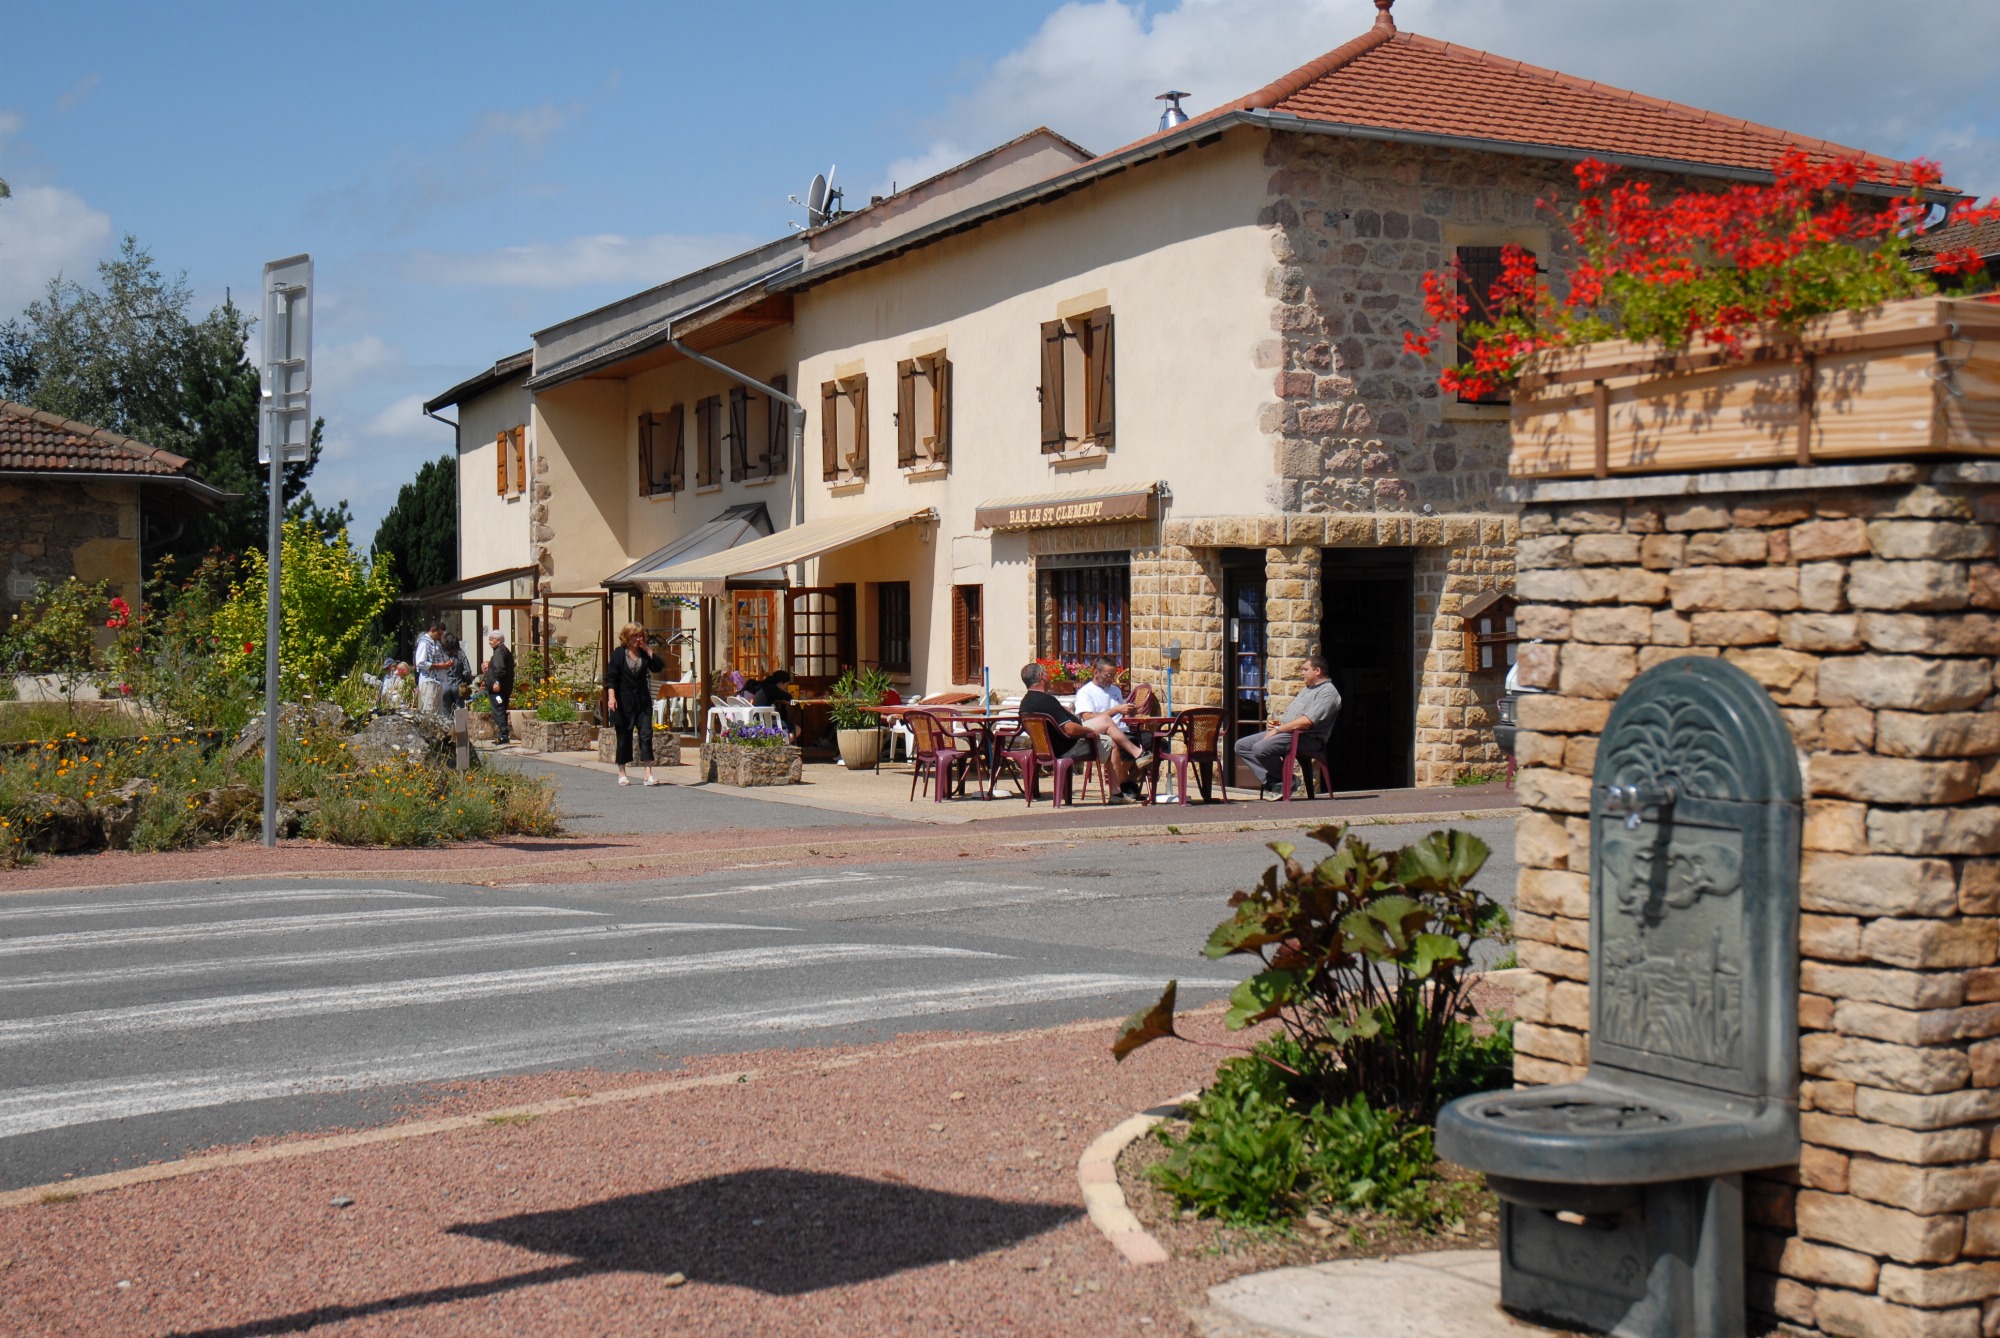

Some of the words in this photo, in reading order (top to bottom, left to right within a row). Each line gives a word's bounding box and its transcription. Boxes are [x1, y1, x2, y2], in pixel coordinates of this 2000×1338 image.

[1009, 509, 1027, 523] BAR
[1029, 508, 1041, 522] LE
[1043, 507, 1054, 521] ST
[1056, 501, 1103, 521] CLEMENT
[647, 581, 666, 593] HOTEL
